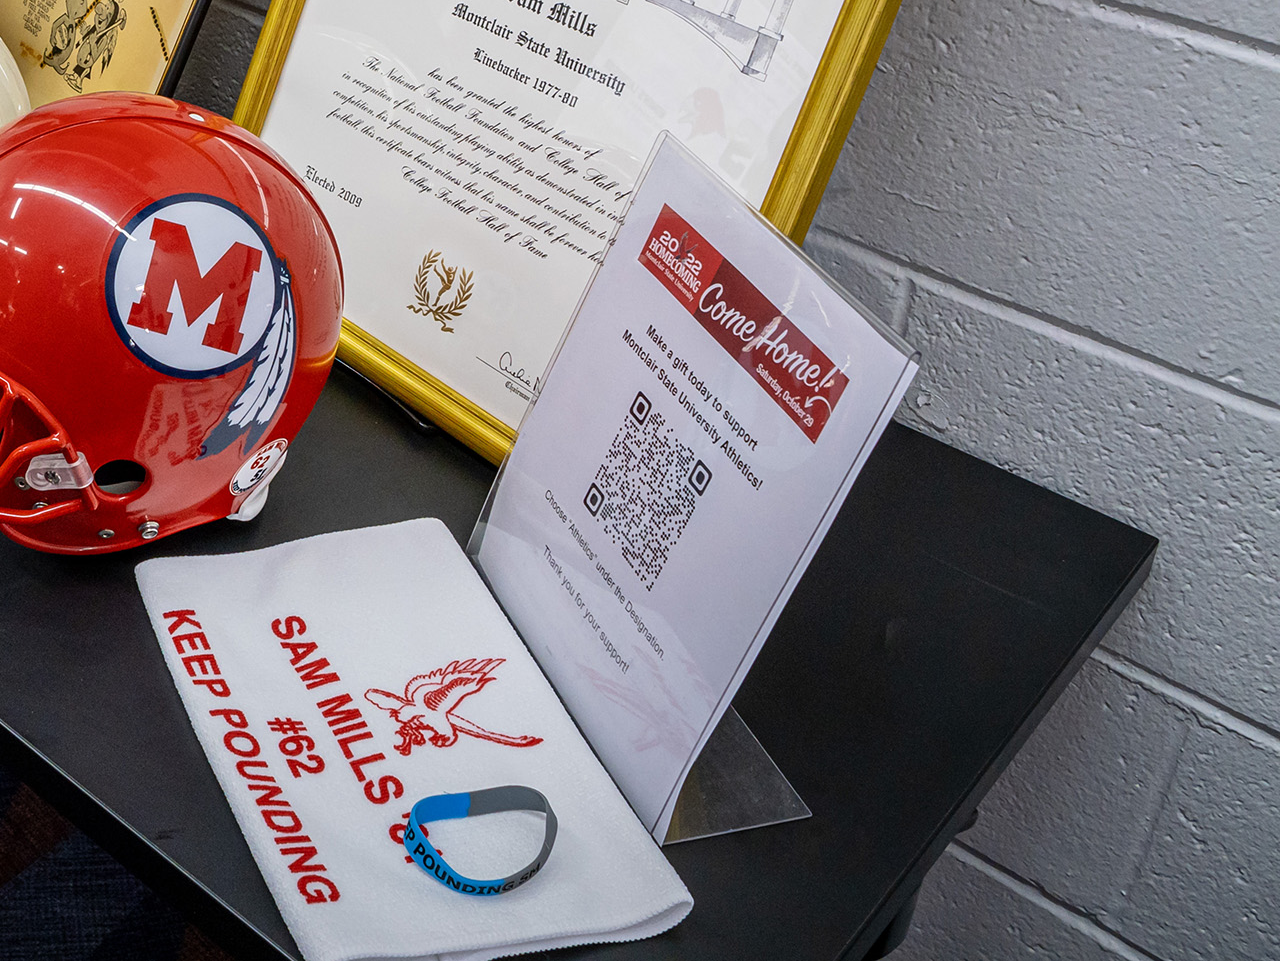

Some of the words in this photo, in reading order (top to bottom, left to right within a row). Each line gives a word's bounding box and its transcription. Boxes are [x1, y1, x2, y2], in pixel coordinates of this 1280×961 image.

[451, 2, 514, 41] Montclair
[514, 30, 551, 59] State
[553, 47, 626, 97] University
[546, 2, 598, 38] Mills
[473, 47, 531, 85] Linebacker
[531, 77, 579, 108] 1977-80
[325, 107, 365, 131] football,
[341, 70, 352, 81] in
[351, 78, 393, 102] recognition
[392, 98, 410, 110] of
[402, 101, 419, 115] his
[415, 111, 464, 143] outstanding
[456, 133, 497, 159] playing
[495, 152, 526, 175] ability
[523, 168, 536, 178] as
[535, 172, 601, 209] demonstrated
[594, 204, 607, 215] in
[359, 124, 376, 139] this
[361, 55, 382, 72] The
[380, 67, 426, 92] National
[423, 86, 467, 113] Football
[464, 107, 515, 142] Foundation
[517, 140, 547, 153] and
[542, 144, 579, 176] College
[582, 167, 620, 192] Hall
[615, 187, 632, 203] of
[426, 67, 449, 82] has
[445, 75, 465, 92] been
[462, 90, 509, 110] granted
[501, 105, 519, 118] the
[517, 112, 555, 136] highest
[551, 129, 584, 152] honors
[585, 148, 600, 161] of
[332, 90, 375, 117] competition,
[374, 109, 393, 123] his
[386, 119, 452, 155] sportsmanship,
[445, 148, 486, 176] integrity,
[482, 168, 526, 198] character,
[523, 193, 550, 207] and
[543, 204, 597, 236] contribution
[596, 230, 608, 241] to
[375, 136, 418, 159] certificate
[412, 152, 438, 171] bears
[433, 167, 469, 189] witness
[303, 164, 337, 193] Elected
[336, 187, 363, 208] 2009
[400, 165, 433, 194] College
[434, 186, 479, 216] Football
[475, 209, 510, 233] Hall
[503, 231, 524, 244] of
[518, 234, 549, 260] Fame
[461, 180, 487, 199] that
[479, 190, 497, 205] his
[494, 202, 520, 218] name
[519, 214, 552, 232] shall
[543, 224, 558, 237] be
[549, 232, 589, 256] forever
[126, 218, 263, 355] M
[648, 237, 702, 293] HOMECOMING
[699, 284, 754, 342] Come
[756, 325, 834, 392] Home!
[621, 328, 659, 374] Montclair
[656, 368, 679, 399] State
[677, 391, 722, 445] University
[719, 439, 764, 491] Athletics!
[645, 324, 668, 355] Make
[664, 349, 674, 364] a
[670, 354, 690, 377] gift
[687, 368, 713, 405] today
[711, 396, 723, 415] to
[722, 409, 759, 452] support
[755, 363, 783, 398] Saturday,
[782, 390, 806, 419] October
[802, 413, 815, 428] 29
[250, 455, 271, 470] 62
[544, 489, 568, 524] Choose
[567, 519, 598, 561] “Athletics”
[595, 561, 616, 589] under
[613, 585, 626, 605] the
[624, 600, 664, 661] Designation.
[543, 544, 563, 579] Thank
[560, 575, 576, 597] you
[574, 592, 586, 610] for
[582, 608, 601, 633] your
[599, 631, 630, 675] support!
[271, 615, 341, 690] SAM
[316, 693, 404, 805] MILLS
[163, 609, 232, 699] KEEP
[209, 708, 341, 904] POUNDING
[267, 717, 326, 778] #62
[413, 842, 516, 895] POUNDING
